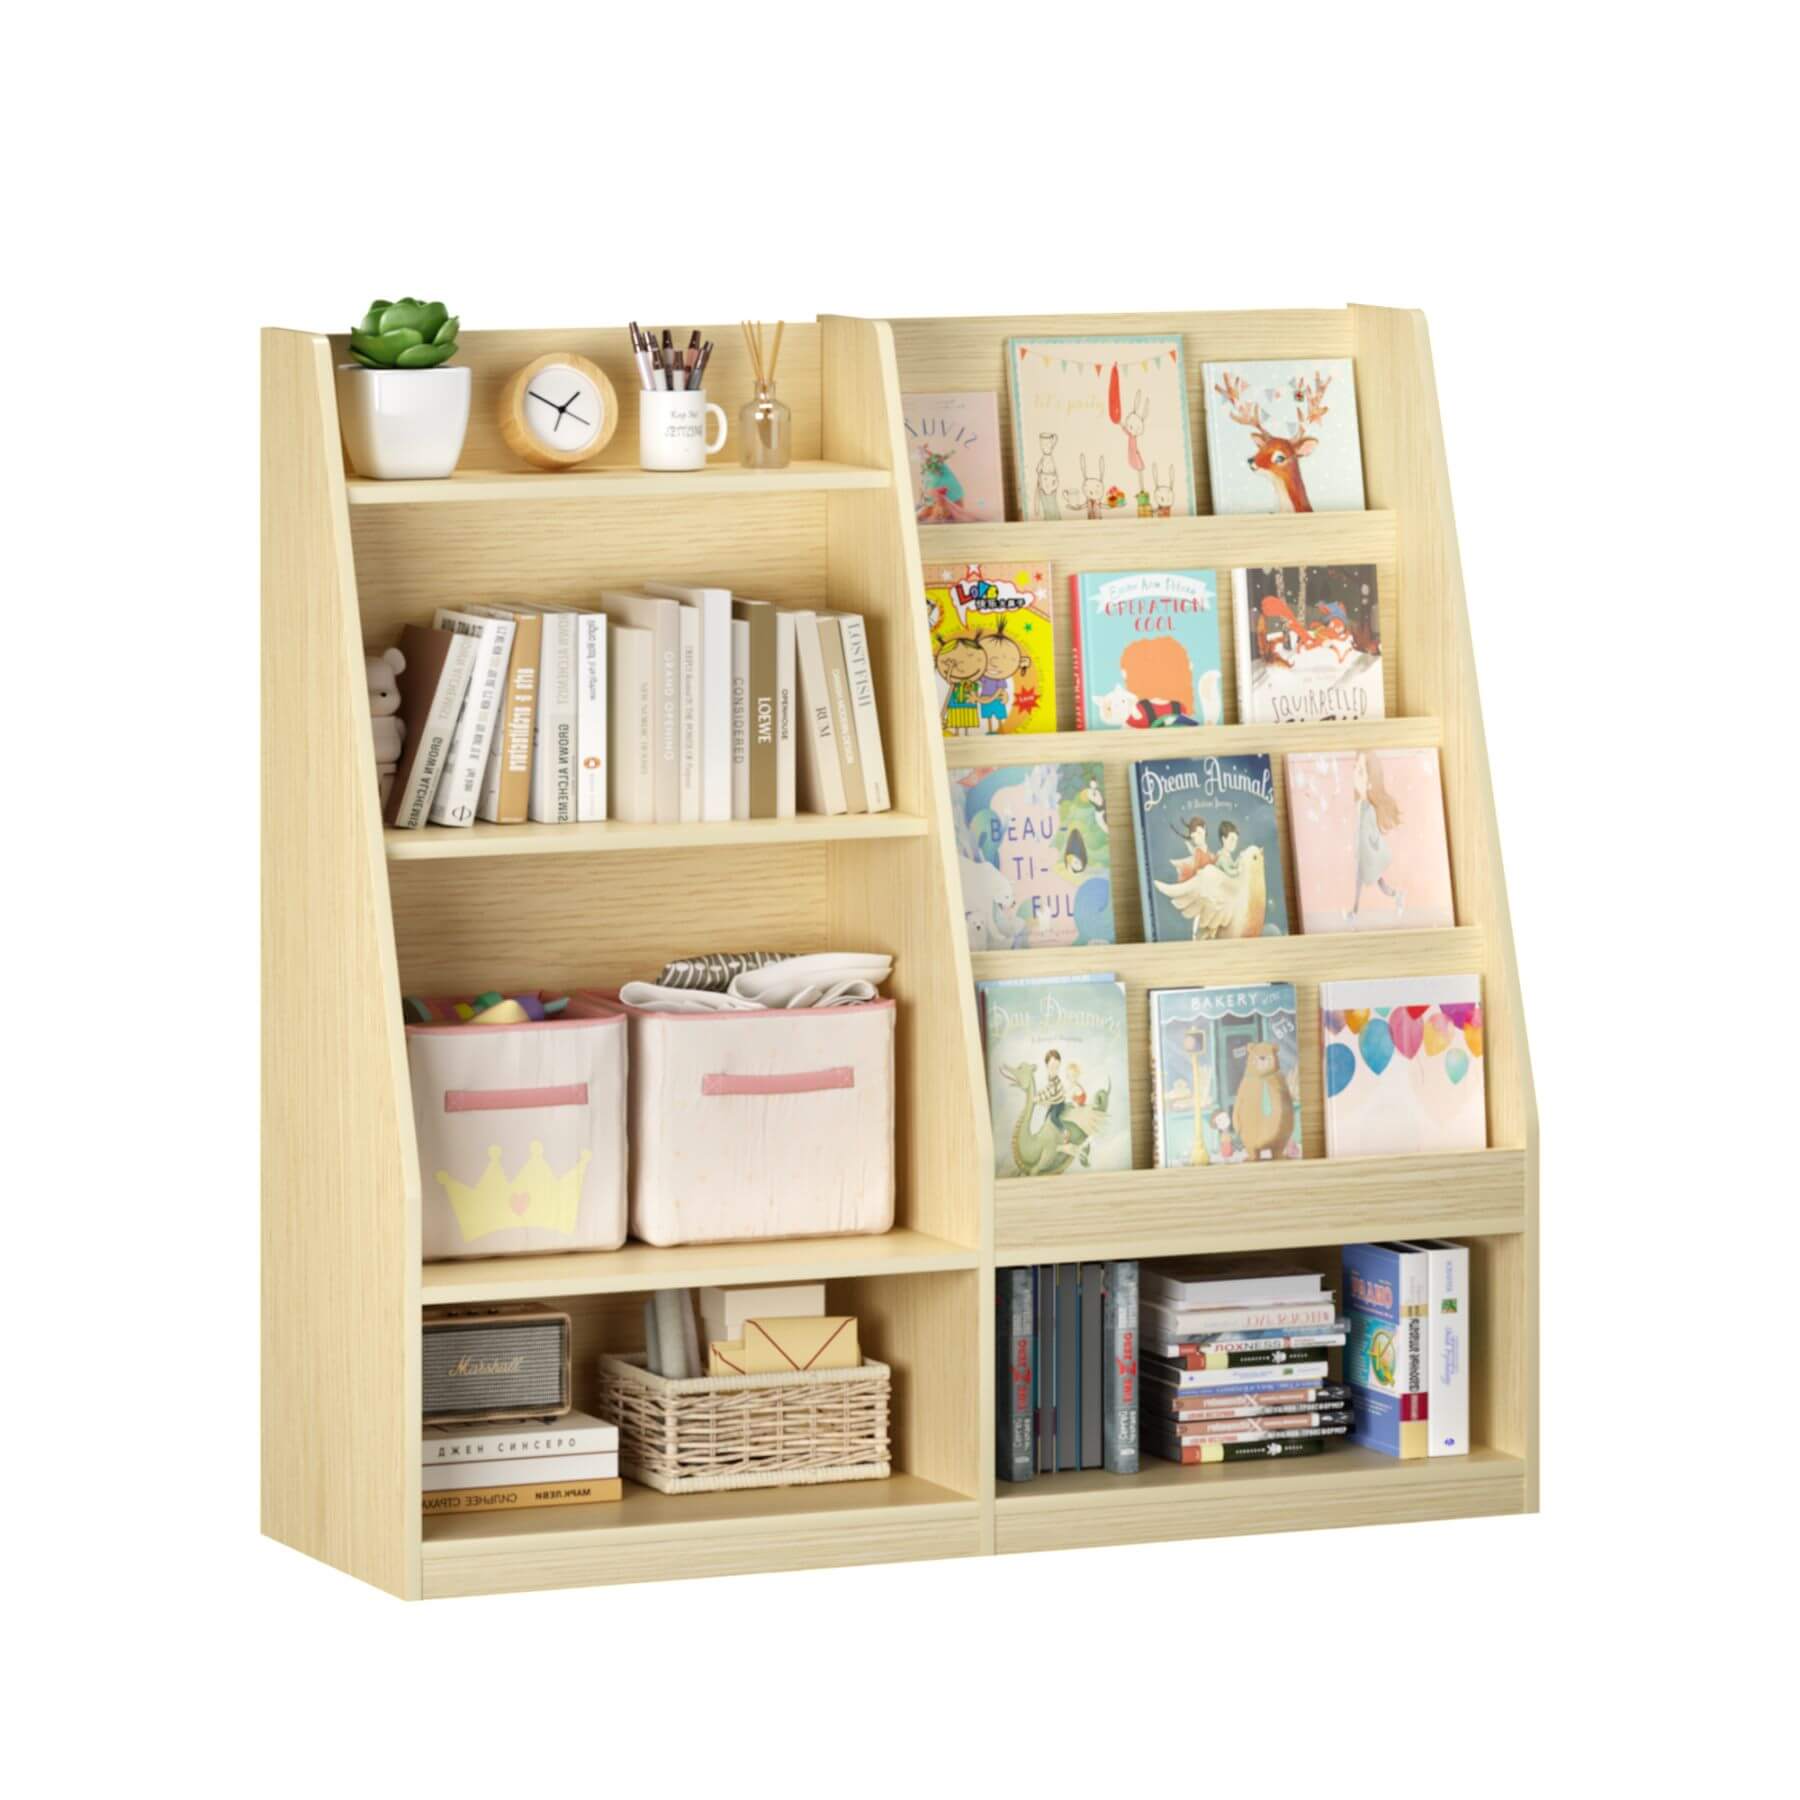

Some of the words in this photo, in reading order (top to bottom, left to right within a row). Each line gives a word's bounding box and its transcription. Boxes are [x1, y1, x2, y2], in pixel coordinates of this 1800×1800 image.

[847, 622, 868, 663] LOST
[855, 664, 872, 708] FISH
[733, 676, 745, 765] CONSIDERED
[757, 697, 772, 744] LOEWE
[781, 688, 790, 741] OPENHOUSE
[815, 706, 832, 738] RUM
[1141, 765, 1201, 812] Dream
[1203, 755, 1275, 805] Animals
[990, 815, 1069, 843] BEAU-
[1012, 856, 1049, 880] TI-
[1032, 893, 1075, 919] FUL
[1191, 991, 1258, 1010] BAKERY
[448, 1354, 526, 1377] Marshall
[438, 1445, 484, 1457] ДЖЕН
[498, 1438, 577, 1452] СИНСЕРО
